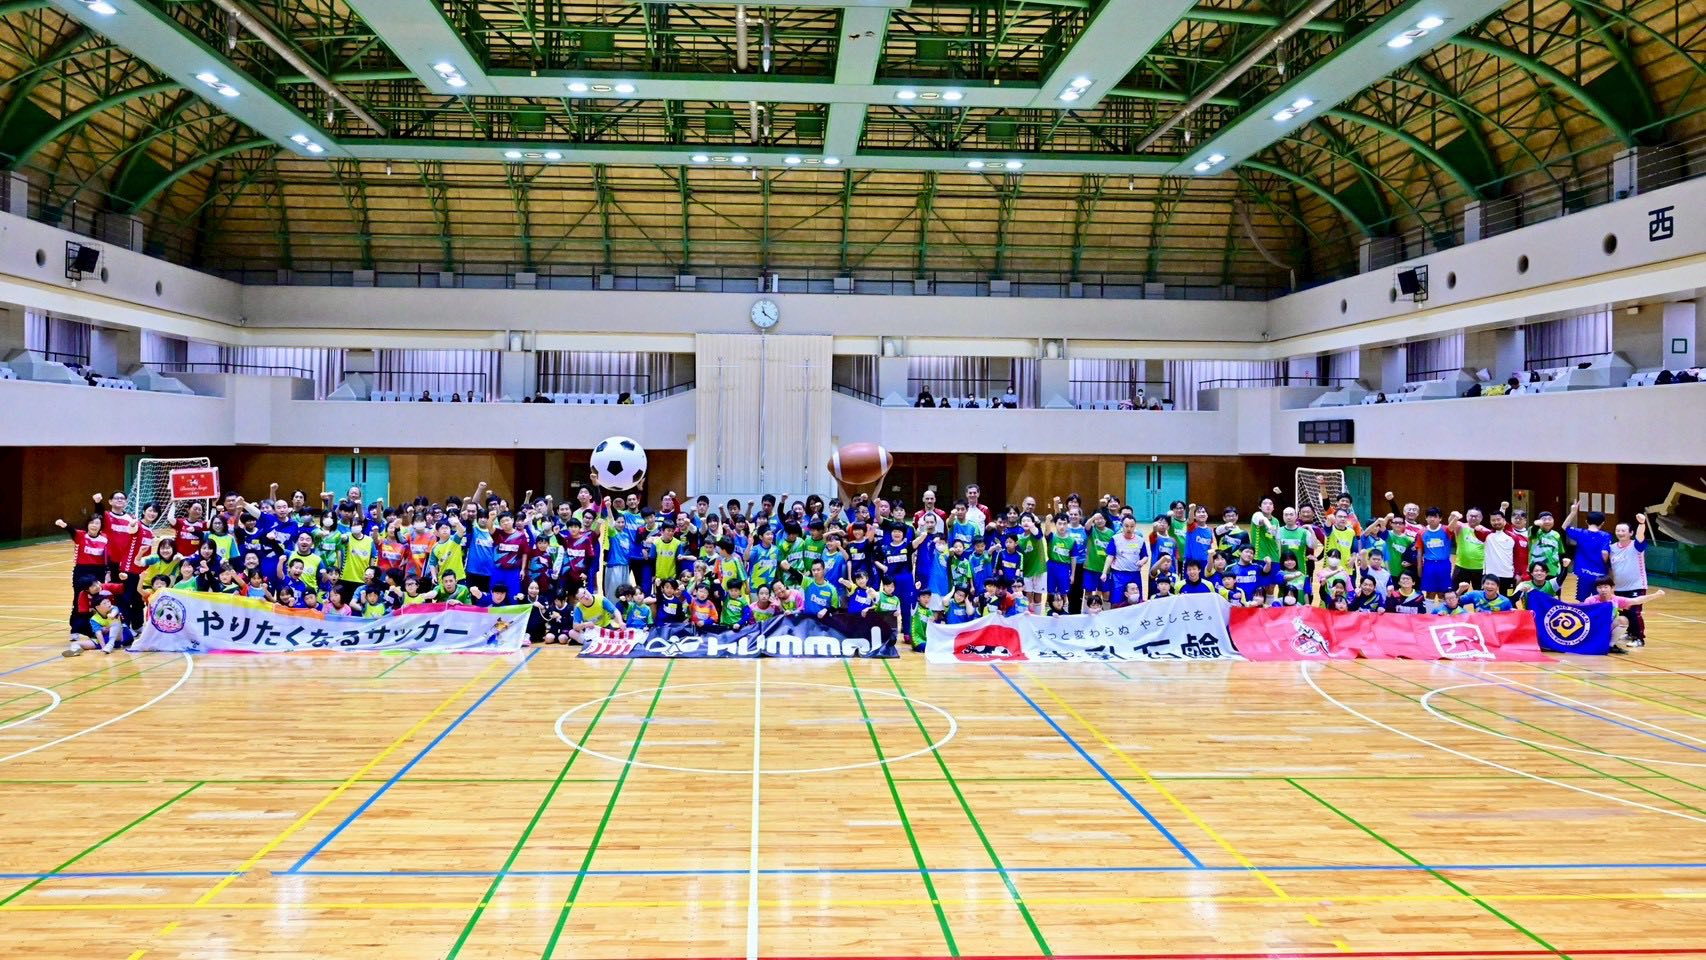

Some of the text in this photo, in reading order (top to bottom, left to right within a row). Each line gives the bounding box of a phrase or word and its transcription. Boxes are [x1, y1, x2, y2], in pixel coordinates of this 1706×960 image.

[1648, 205, 1675, 242] 西
[196, 610, 469, 647] やりたくなるサッカー
[1140, 609, 1213, 630] やさしさを。
